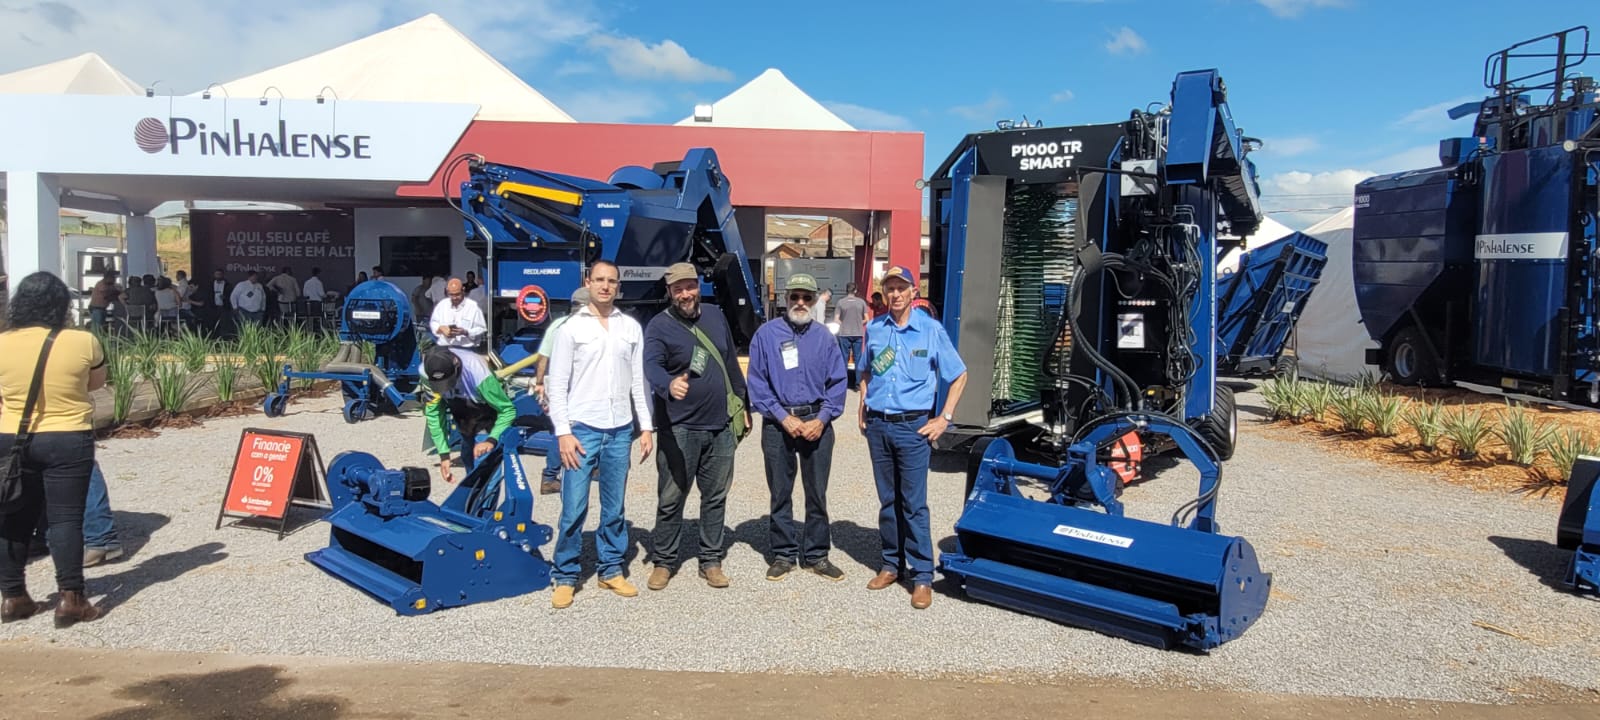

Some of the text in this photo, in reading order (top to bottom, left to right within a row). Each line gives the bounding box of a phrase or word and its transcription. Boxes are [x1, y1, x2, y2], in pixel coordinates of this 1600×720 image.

[1011, 140, 1083, 157] P1000 TR
[1020, 155, 1074, 170] SMART
[227, 231, 264, 245] AQUI,
[266, 231, 293, 243] SEU
[248, 245, 302, 257] SEMPRE
[305, 246, 325, 257] EM
[328, 246, 355, 257] ALT
[253, 438, 291, 452] Financie
[253, 466, 273, 482] 0%
